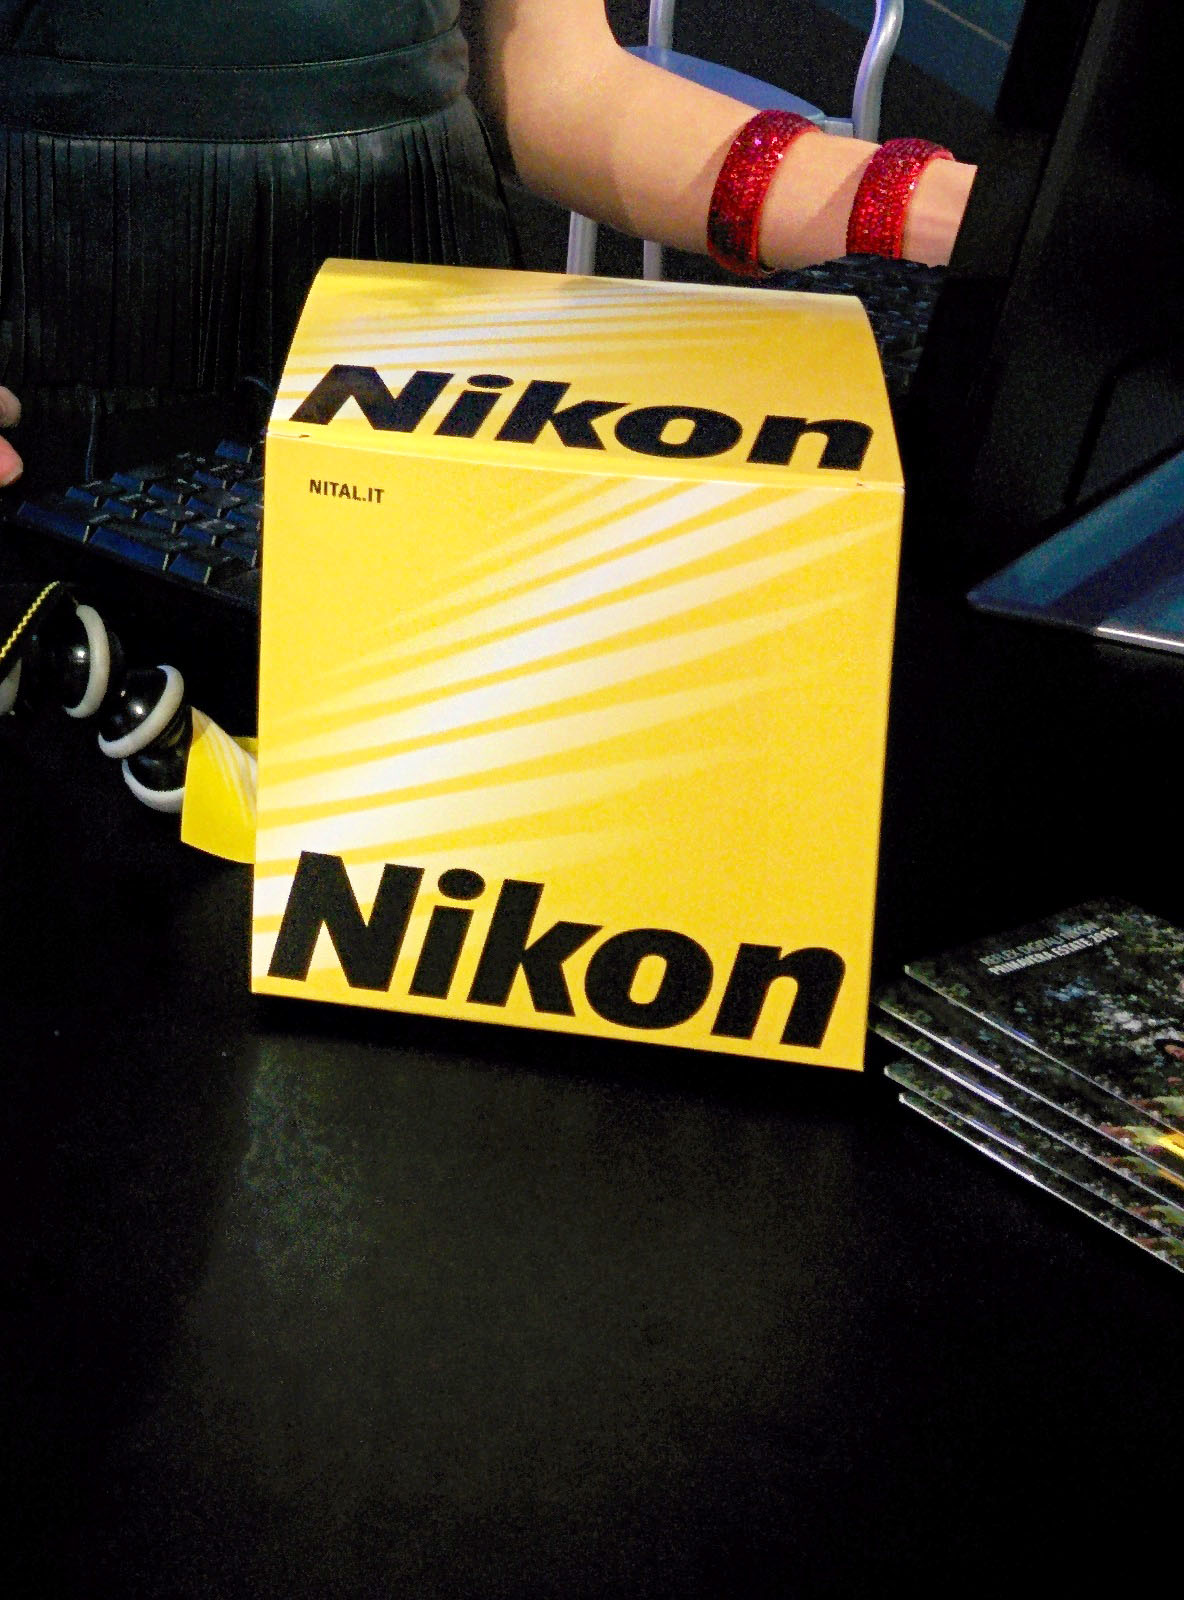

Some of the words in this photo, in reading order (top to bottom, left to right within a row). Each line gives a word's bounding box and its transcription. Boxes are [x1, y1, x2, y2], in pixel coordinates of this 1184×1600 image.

[289, 364, 874, 471] Nikon
[309, 478, 385, 504] NITAL.IT
[266, 849, 848, 1050] Nikon
